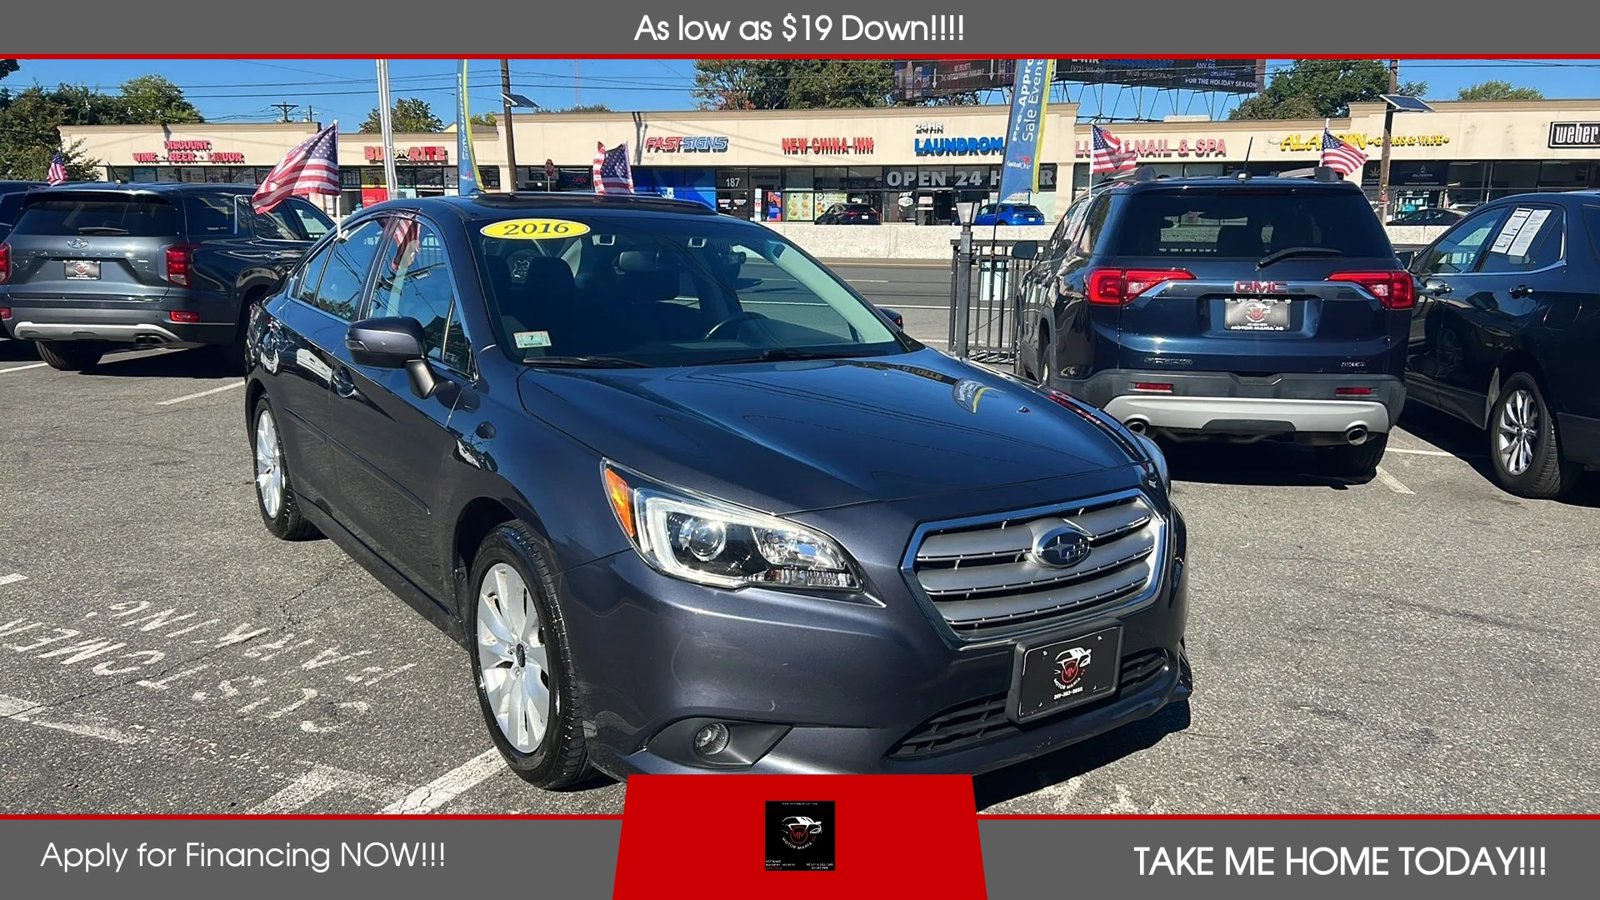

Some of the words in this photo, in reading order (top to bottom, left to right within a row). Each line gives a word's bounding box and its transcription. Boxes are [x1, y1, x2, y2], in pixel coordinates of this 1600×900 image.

[1028, 59, 1045, 104] Event
[1210, 78, 1235, 87] HOLIDAY
[1022, 110, 1037, 142] Sale
[1555, 123, 1599, 144] weber
[164, 140, 212, 152] DISCOUNT
[782, 137, 807, 153] NEW
[812, 137, 849, 153] CHINA
[853, 137, 874, 153] INN
[1135, 139, 1172, 157] NAIL
[1178, 139, 1189, 157] &
[1196, 139, 1226, 157] SPA
[132, 153, 158, 163] WINE
[168, 153, 197, 163] BEER
[409, 146, 447, 162] RITE
[725, 178, 740, 187] 187
[886, 170, 947, 187] OPEN
[954, 170, 982, 187] 24
[504, 222, 570, 236] 2016
[1234, 280, 1288, 294] GMC
